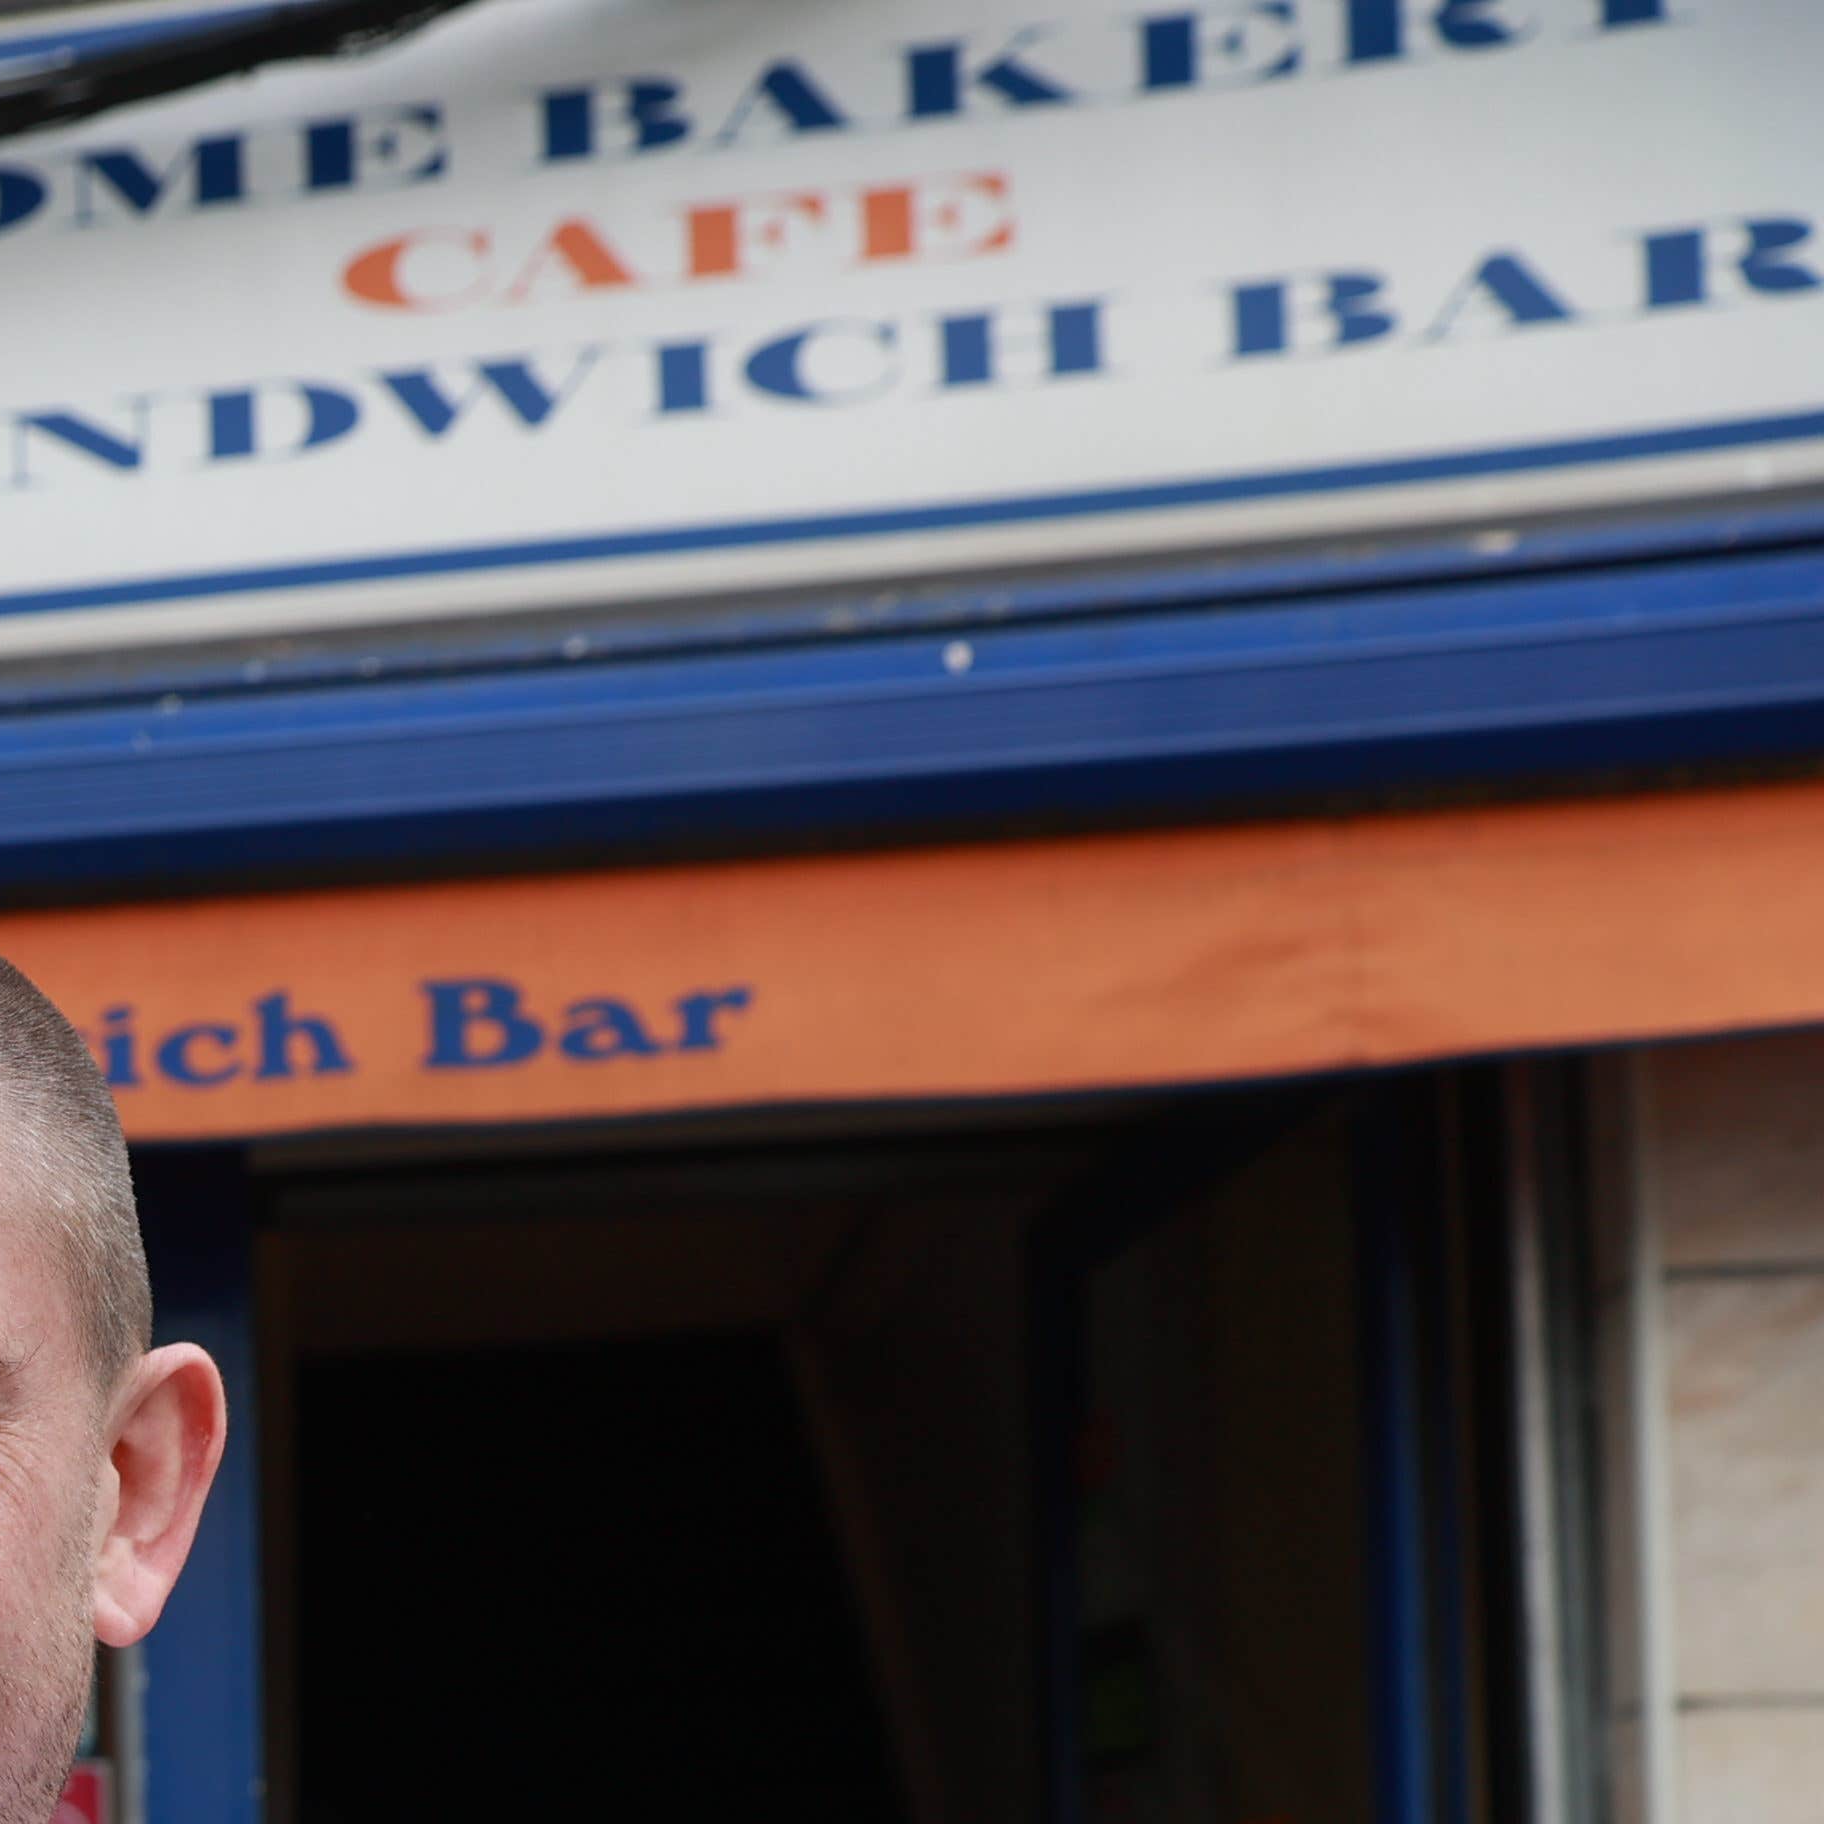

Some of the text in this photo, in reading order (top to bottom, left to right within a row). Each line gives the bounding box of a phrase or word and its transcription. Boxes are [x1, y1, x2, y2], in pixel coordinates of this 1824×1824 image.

[337, 168, 1019, 315] CAFE
[1214, 214, 1824, 369] BAR
[416, 975, 753, 1073] Bar
